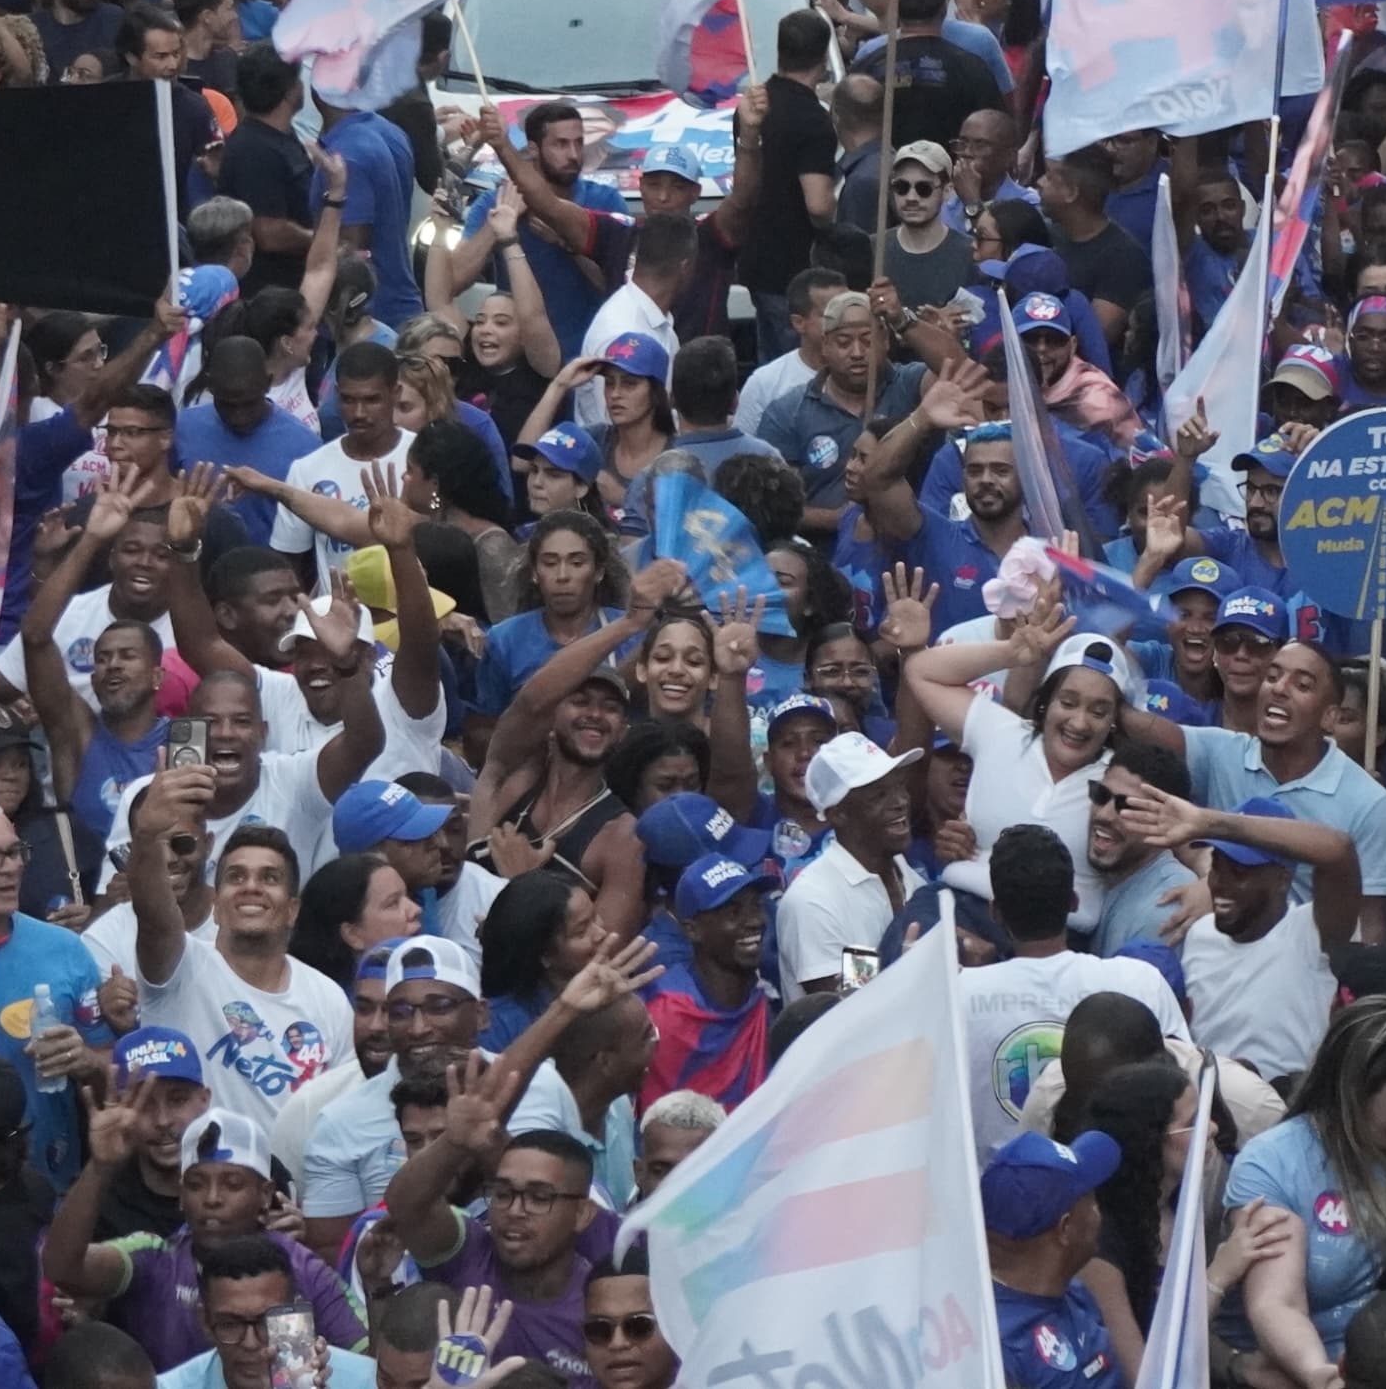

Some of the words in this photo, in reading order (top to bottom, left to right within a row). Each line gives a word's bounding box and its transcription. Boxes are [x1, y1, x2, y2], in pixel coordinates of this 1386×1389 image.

[1307, 458, 1344, 480] NA
[1284, 495, 1381, 531] ACM
[1316, 537, 1366, 554] Muda
[297, 1044, 323, 1062] 44
[1319, 1198, 1350, 1230] 44
